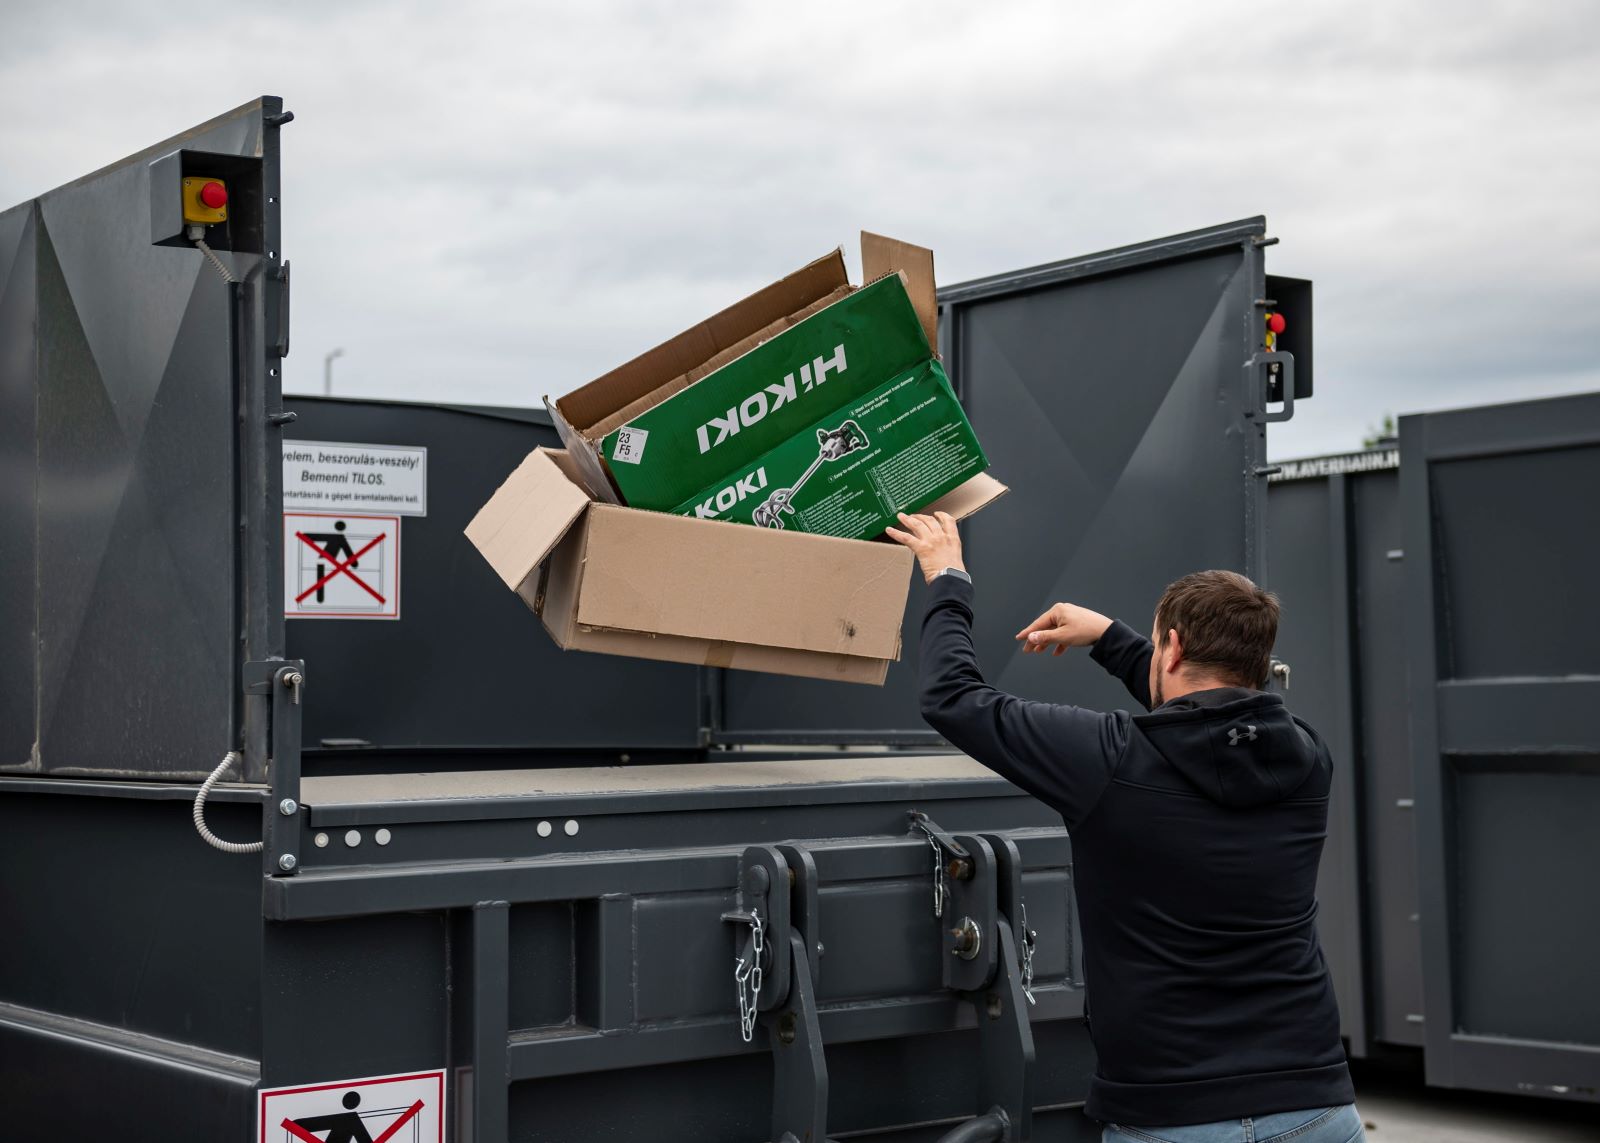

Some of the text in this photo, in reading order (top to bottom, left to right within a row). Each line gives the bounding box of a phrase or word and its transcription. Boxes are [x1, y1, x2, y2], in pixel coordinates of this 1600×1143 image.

[619, 432, 631, 444] 23
[619, 444, 631, 456] F5
[318, 451, 420, 470] beszorulás-veszély!
[301, 469, 349, 483] Bemenni
[283, 490, 323, 500] ntartásnál
[331, 491, 352, 502] gépet
